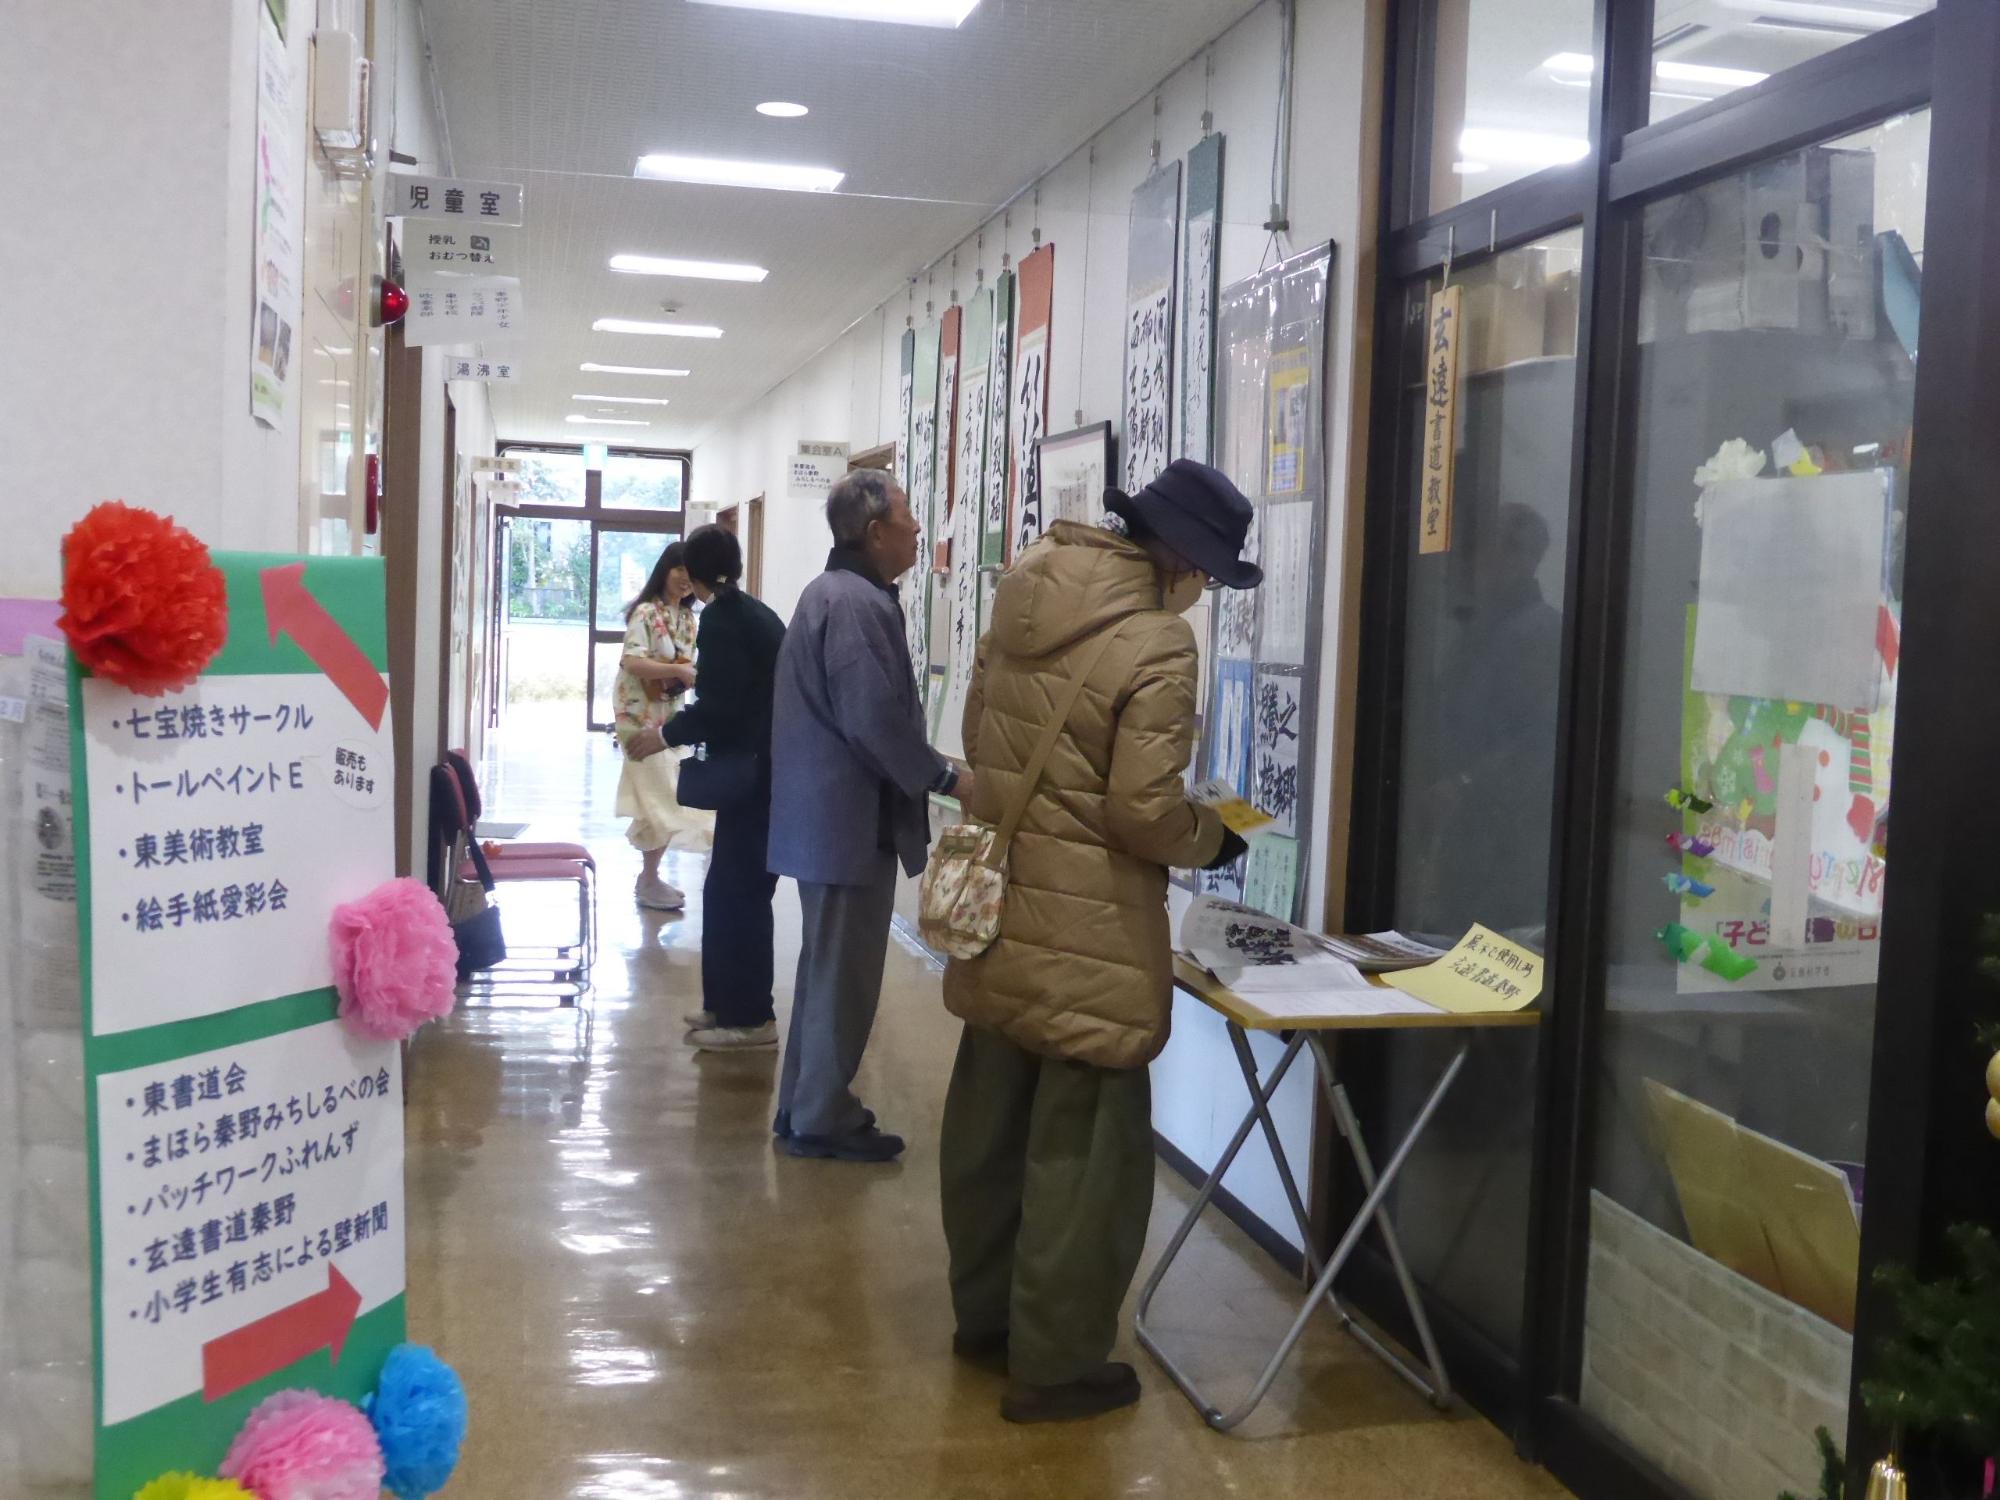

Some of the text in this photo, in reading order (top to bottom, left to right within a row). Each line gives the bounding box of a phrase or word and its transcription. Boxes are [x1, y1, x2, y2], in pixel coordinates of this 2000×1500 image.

[409, 185, 501, 216] 児童室
[428, 251, 495, 264] おむつ替え
[456, 362, 511, 378] 湯沸室
[335, 746, 367, 772] 販売も
[334, 769, 375, 794] あります
